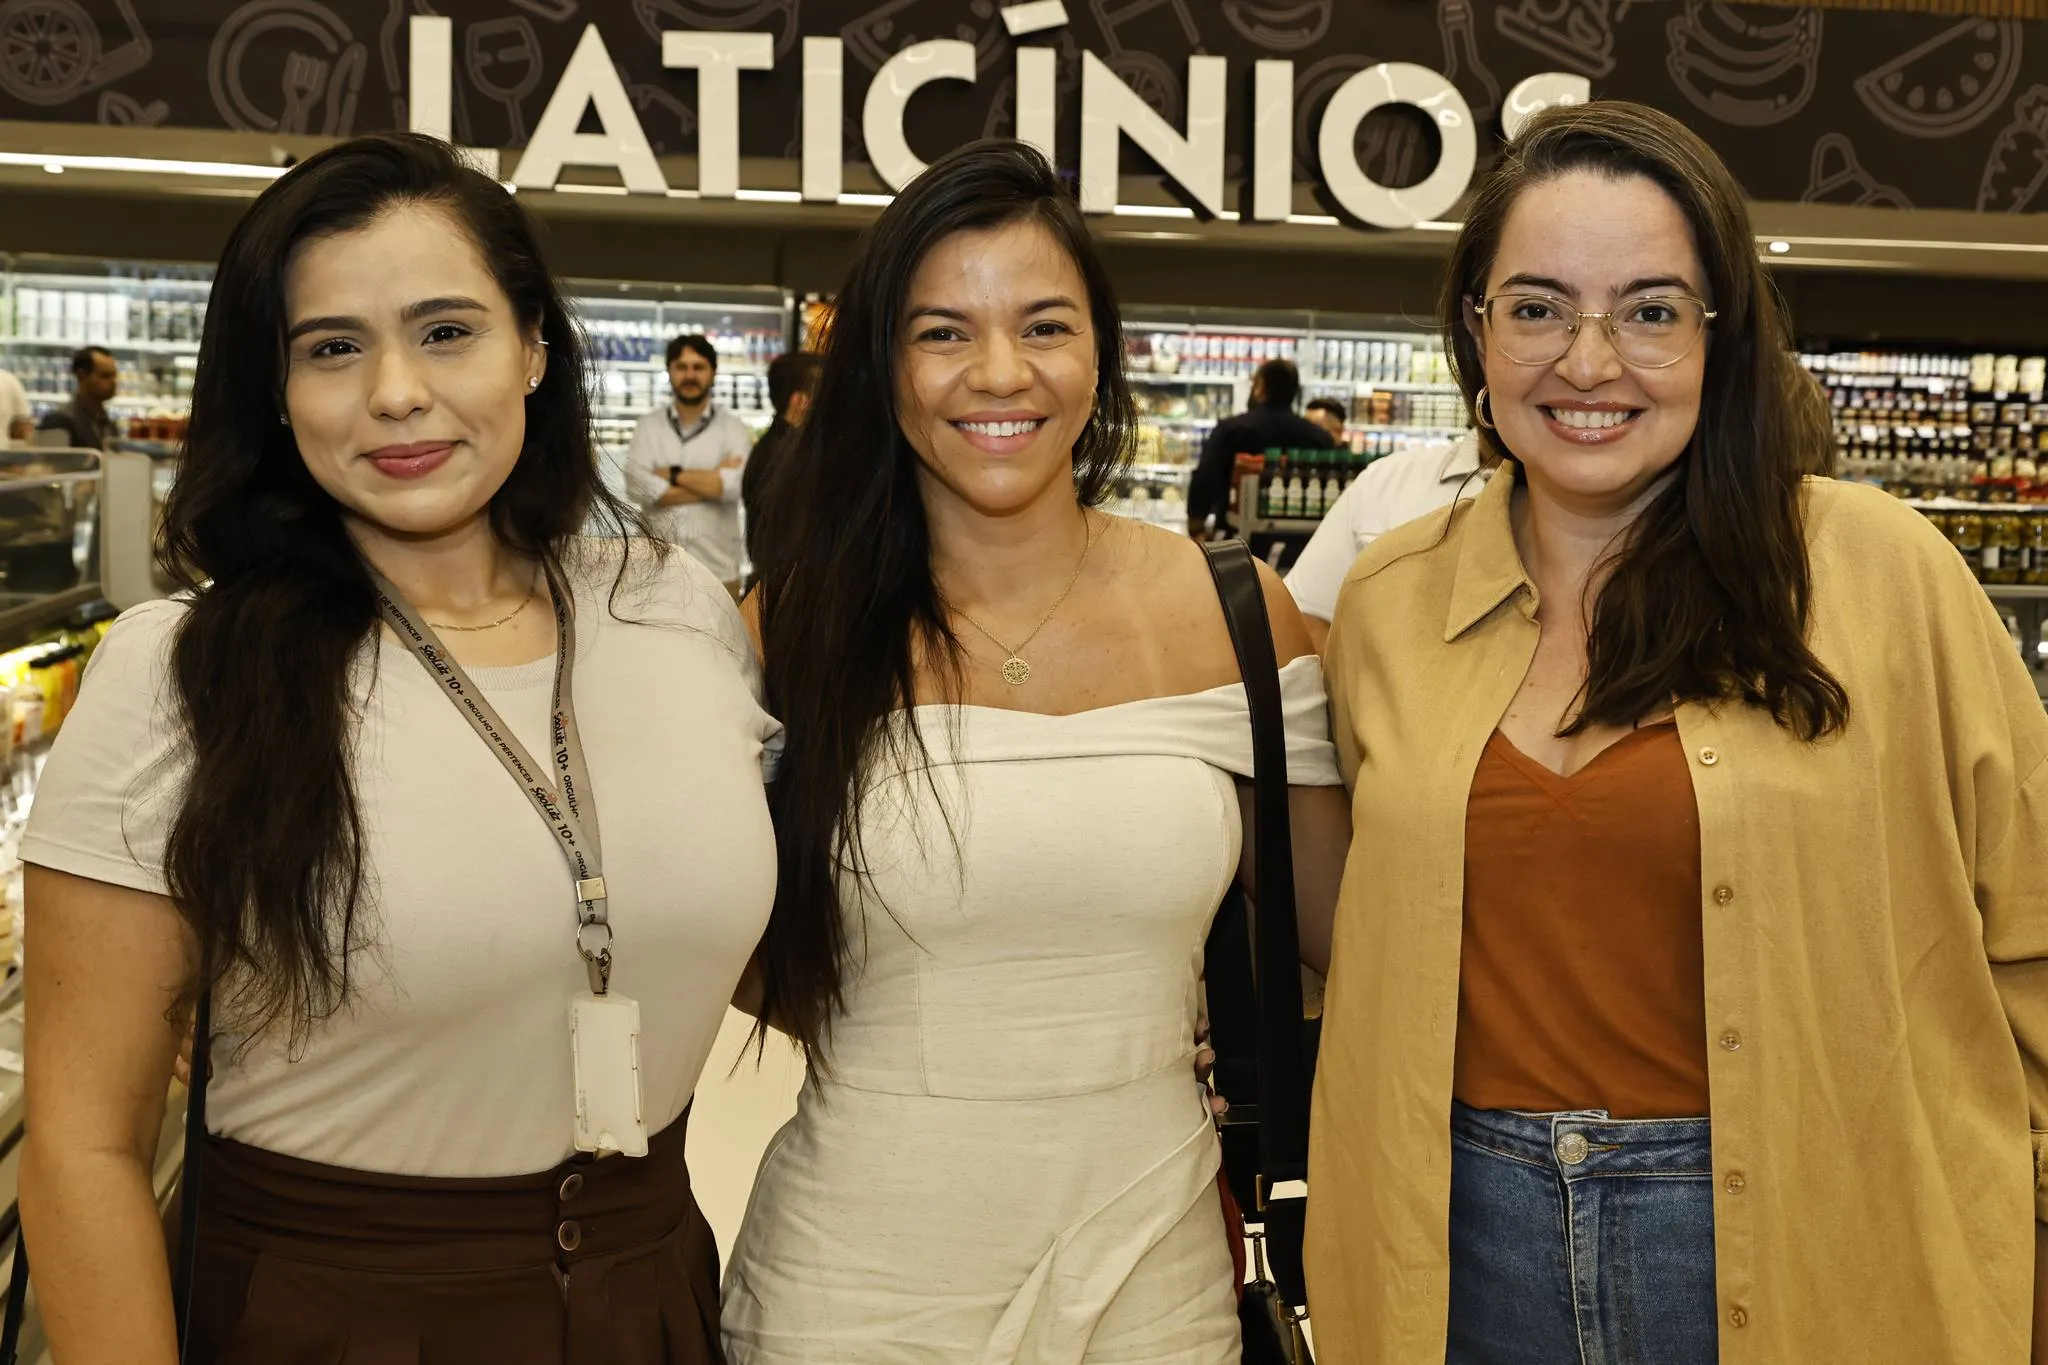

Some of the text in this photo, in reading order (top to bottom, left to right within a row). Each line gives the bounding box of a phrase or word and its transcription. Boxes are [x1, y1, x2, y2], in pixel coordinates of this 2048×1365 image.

[388, 605, 423, 642] PERTENCER
[445, 676, 464, 696] 10+
[463, 698, 493, 731] ORGULHO
[490, 732, 502, 743] DE
[499, 742, 534, 783] PERTENCER
[557, 824, 575, 846] 10+
[575, 851, 590, 880] ORGU
[556, 747, 569, 771] 10+
